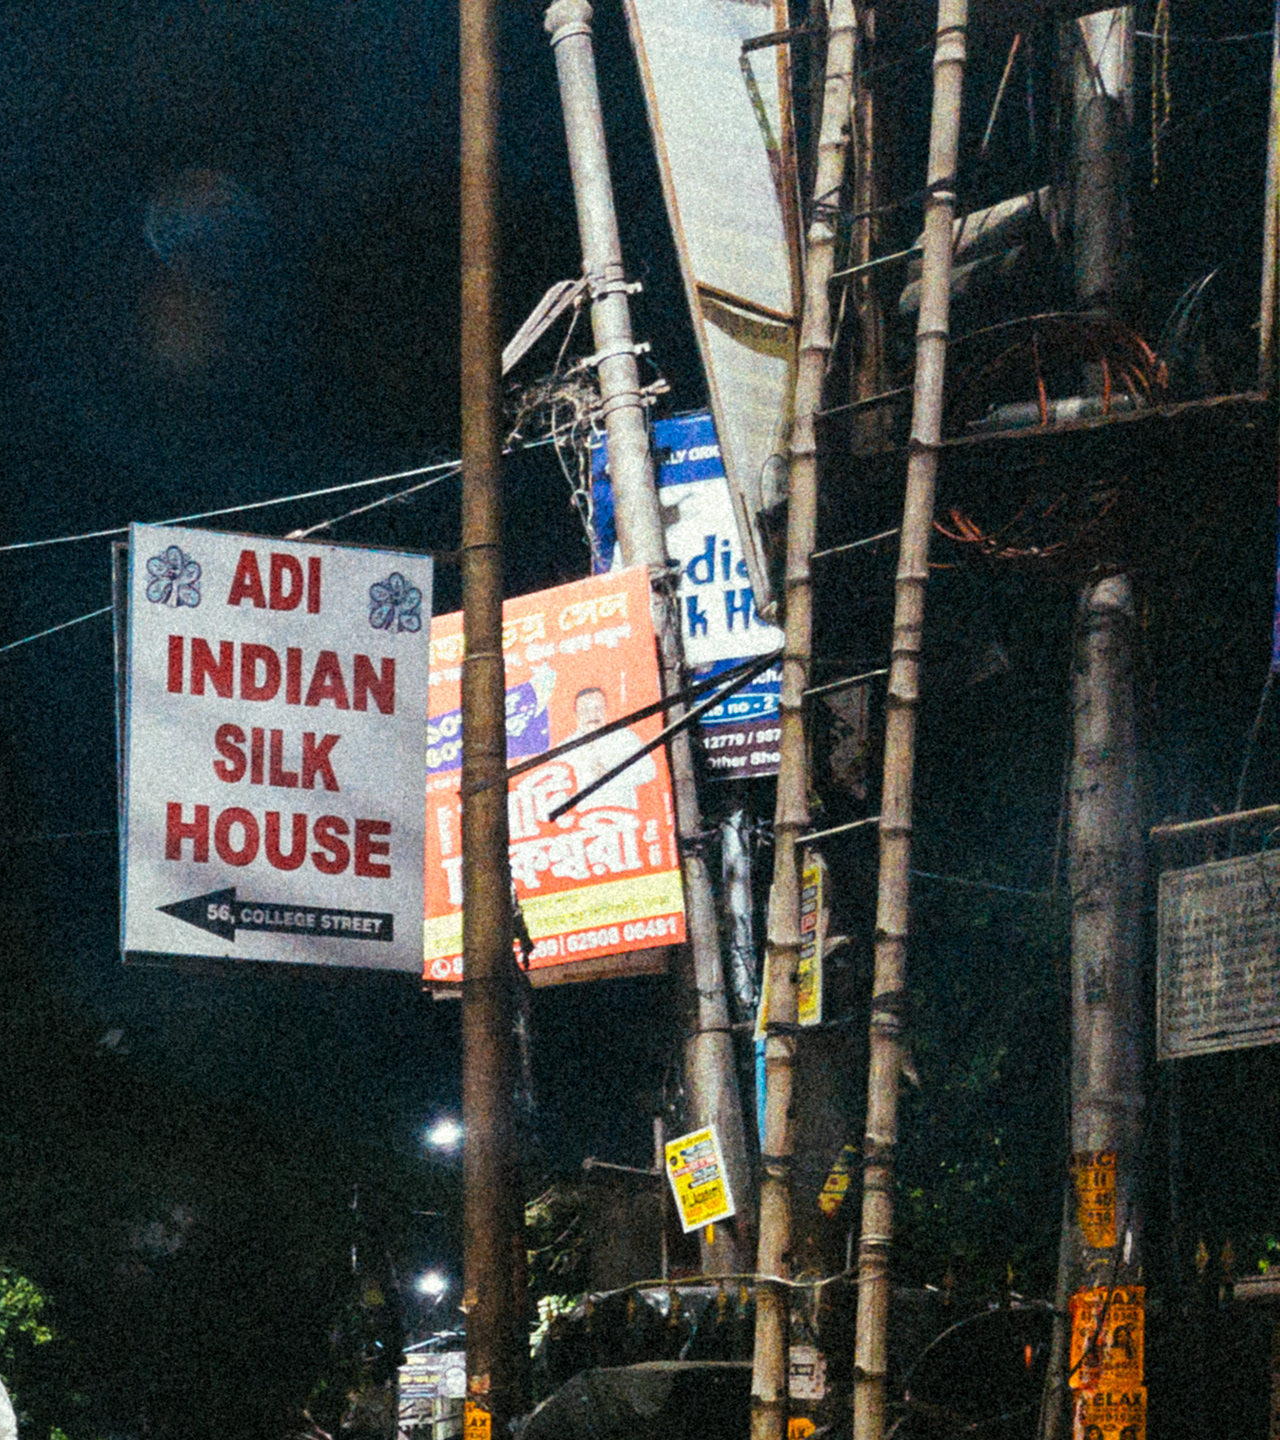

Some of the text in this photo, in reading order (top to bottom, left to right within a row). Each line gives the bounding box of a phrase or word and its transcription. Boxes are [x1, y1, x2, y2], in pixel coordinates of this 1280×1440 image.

[228, 550, 322, 614] ADI
[167, 635, 396, 715] INDIAN
[763, 697, 774, 710] 2
[213, 723, 340, 792] SILK
[166, 802, 392, 879] HOUSE
[207, 903, 383, 933] 56, COLLEGE STREET
